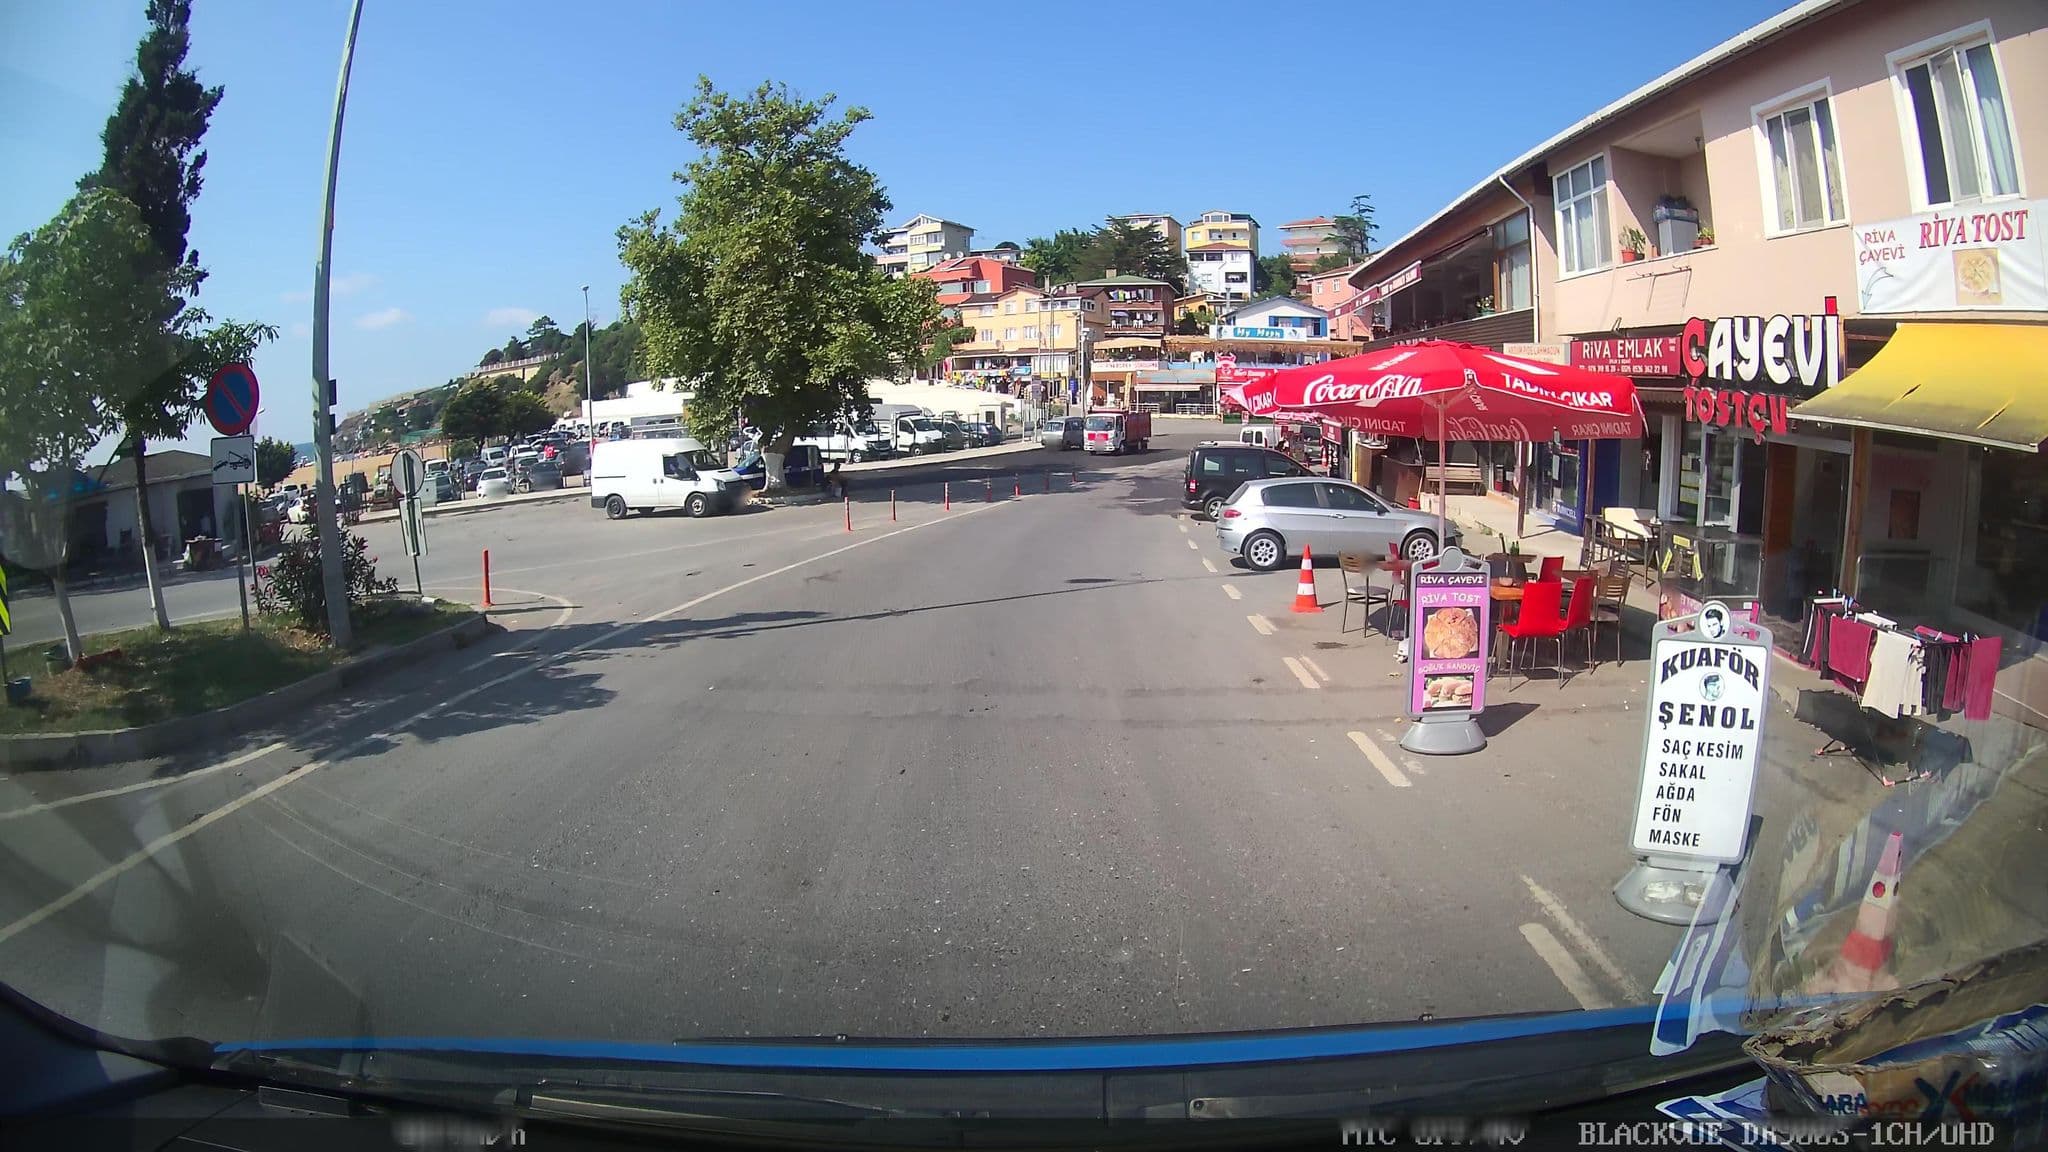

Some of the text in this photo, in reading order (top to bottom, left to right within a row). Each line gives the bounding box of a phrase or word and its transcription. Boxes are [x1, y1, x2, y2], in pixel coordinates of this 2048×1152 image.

[1864, 229, 1896, 244] RİVA
[1919, 209, 2029, 249] RİVA TOST
[1859, 244, 1905, 265] ÇAYEVİ
[1617, 338, 1663, 359] EMLAK
[1682, 296, 1839, 389] ÇAYEVİ
[1420, 575, 1445, 584] RİVA
[1453, 592, 1482, 604] TOST
[1660, 647, 1760, 692] KUAFÖR
[1658, 701, 1755, 730] ŞENOL
[1662, 738, 1744, 760] SAÇ KESİM
[1659, 762, 1707, 780] SAKAL
[1655, 782, 1696, 802] AĞDA
[1652, 803, 1682, 823] FÖN
[1648, 828, 1701, 847] MASKE
